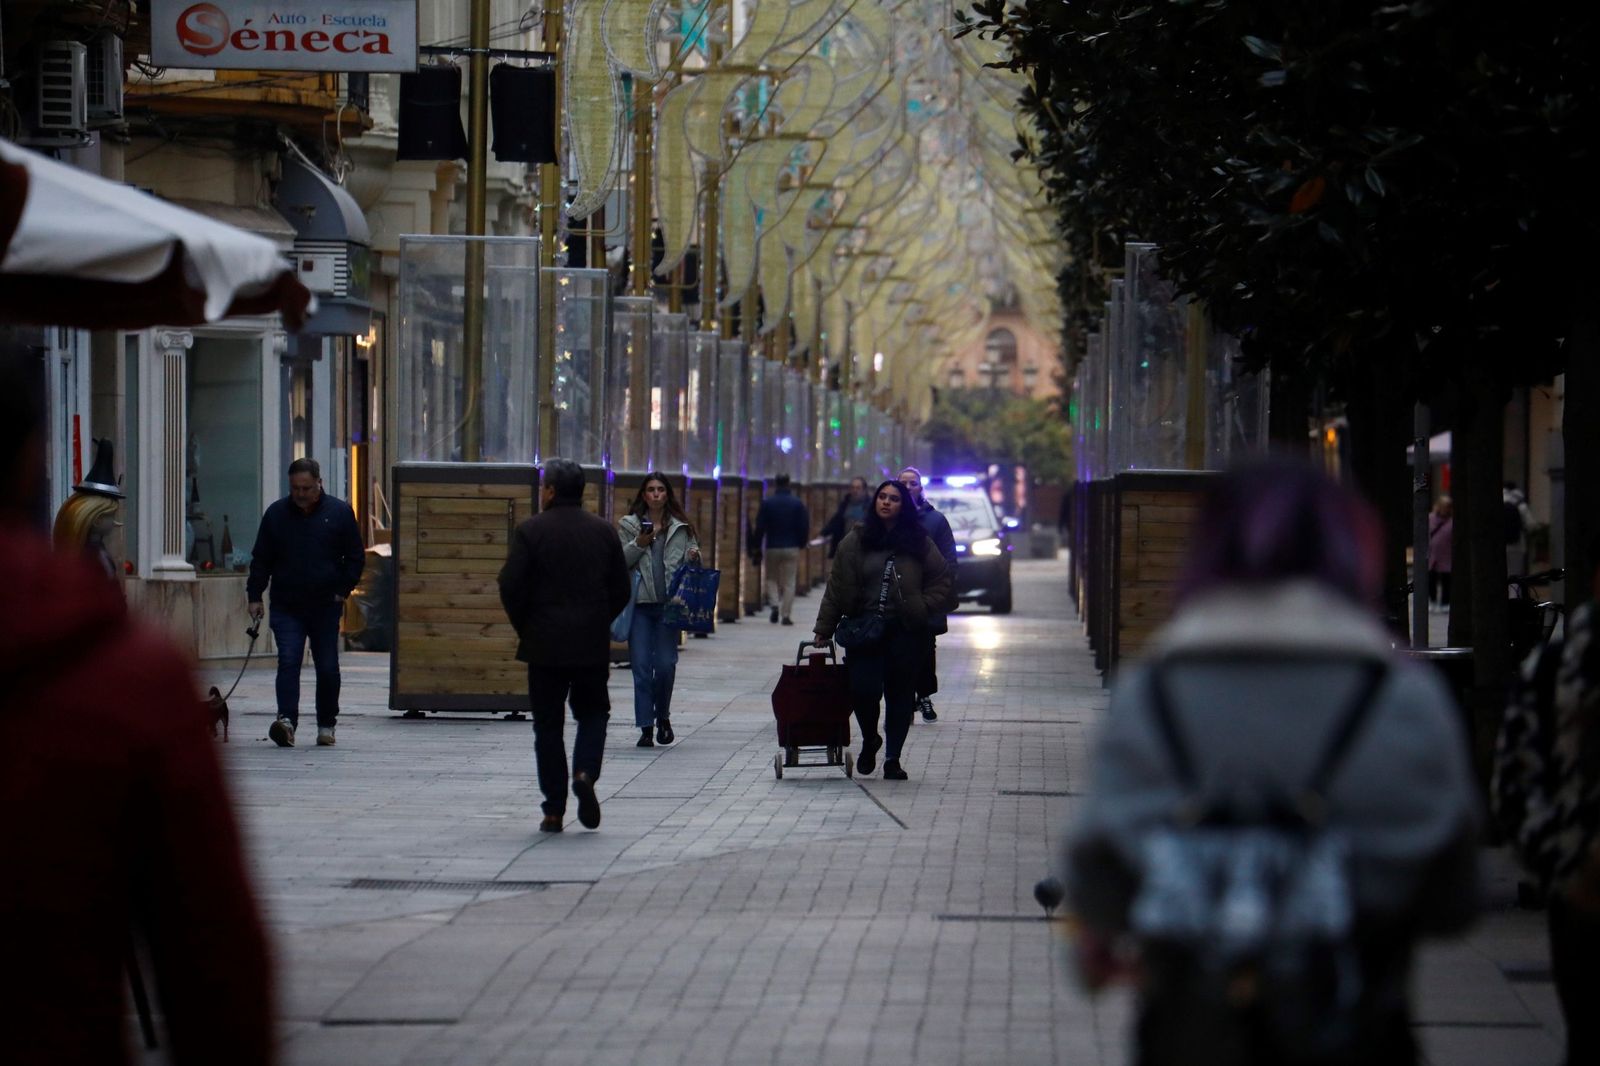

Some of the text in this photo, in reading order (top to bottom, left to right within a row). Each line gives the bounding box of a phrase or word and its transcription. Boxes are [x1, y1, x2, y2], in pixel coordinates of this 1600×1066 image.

[177, 3, 393, 55] Séneca
[268, 13, 306, 24] Auto
[322, 14, 386, 27] Escuela
